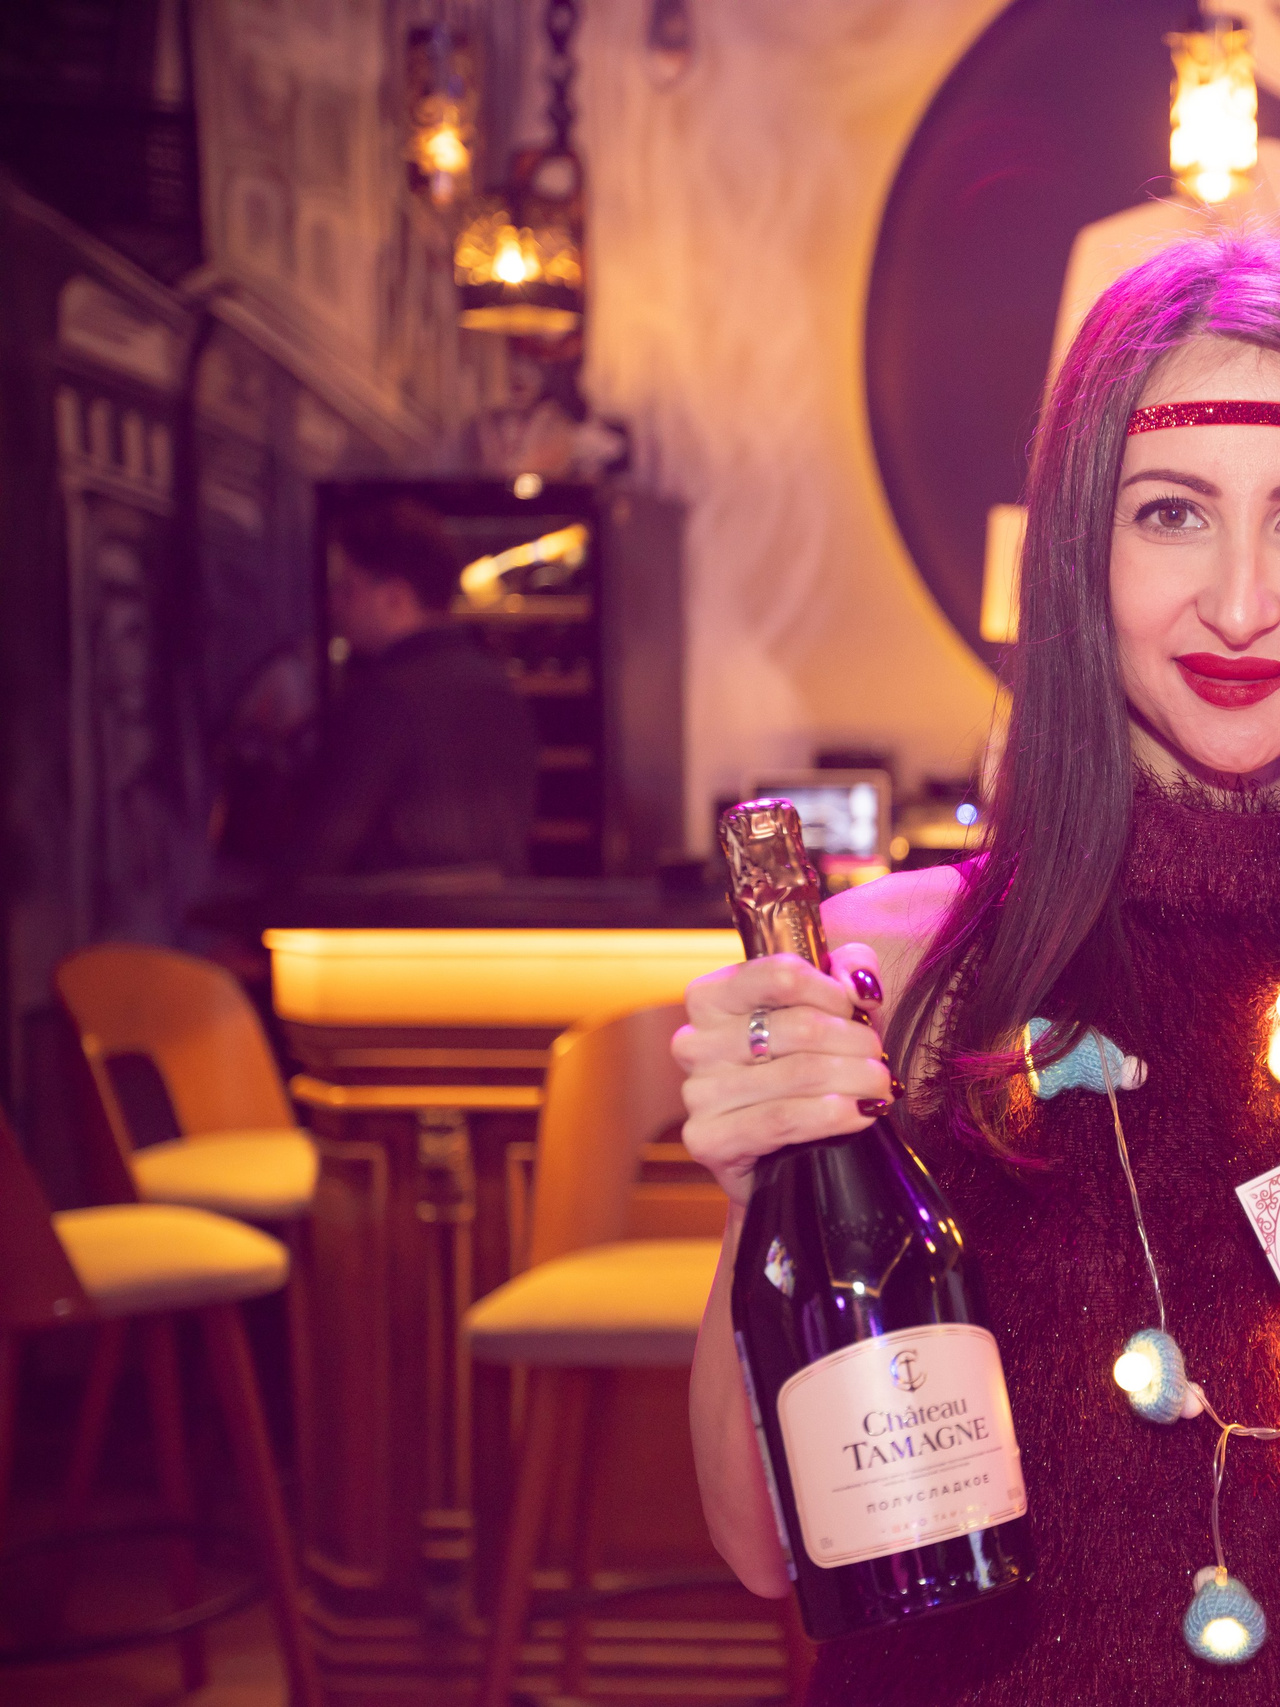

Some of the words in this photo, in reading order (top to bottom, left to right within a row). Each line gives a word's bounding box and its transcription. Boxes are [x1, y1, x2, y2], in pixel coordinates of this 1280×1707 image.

[863, 1398, 968, 1437] Château
[843, 1417, 990, 1471] TAMAGNE
[867, 1474, 990, 1514] ПОЛУСЛАДКОЕ
